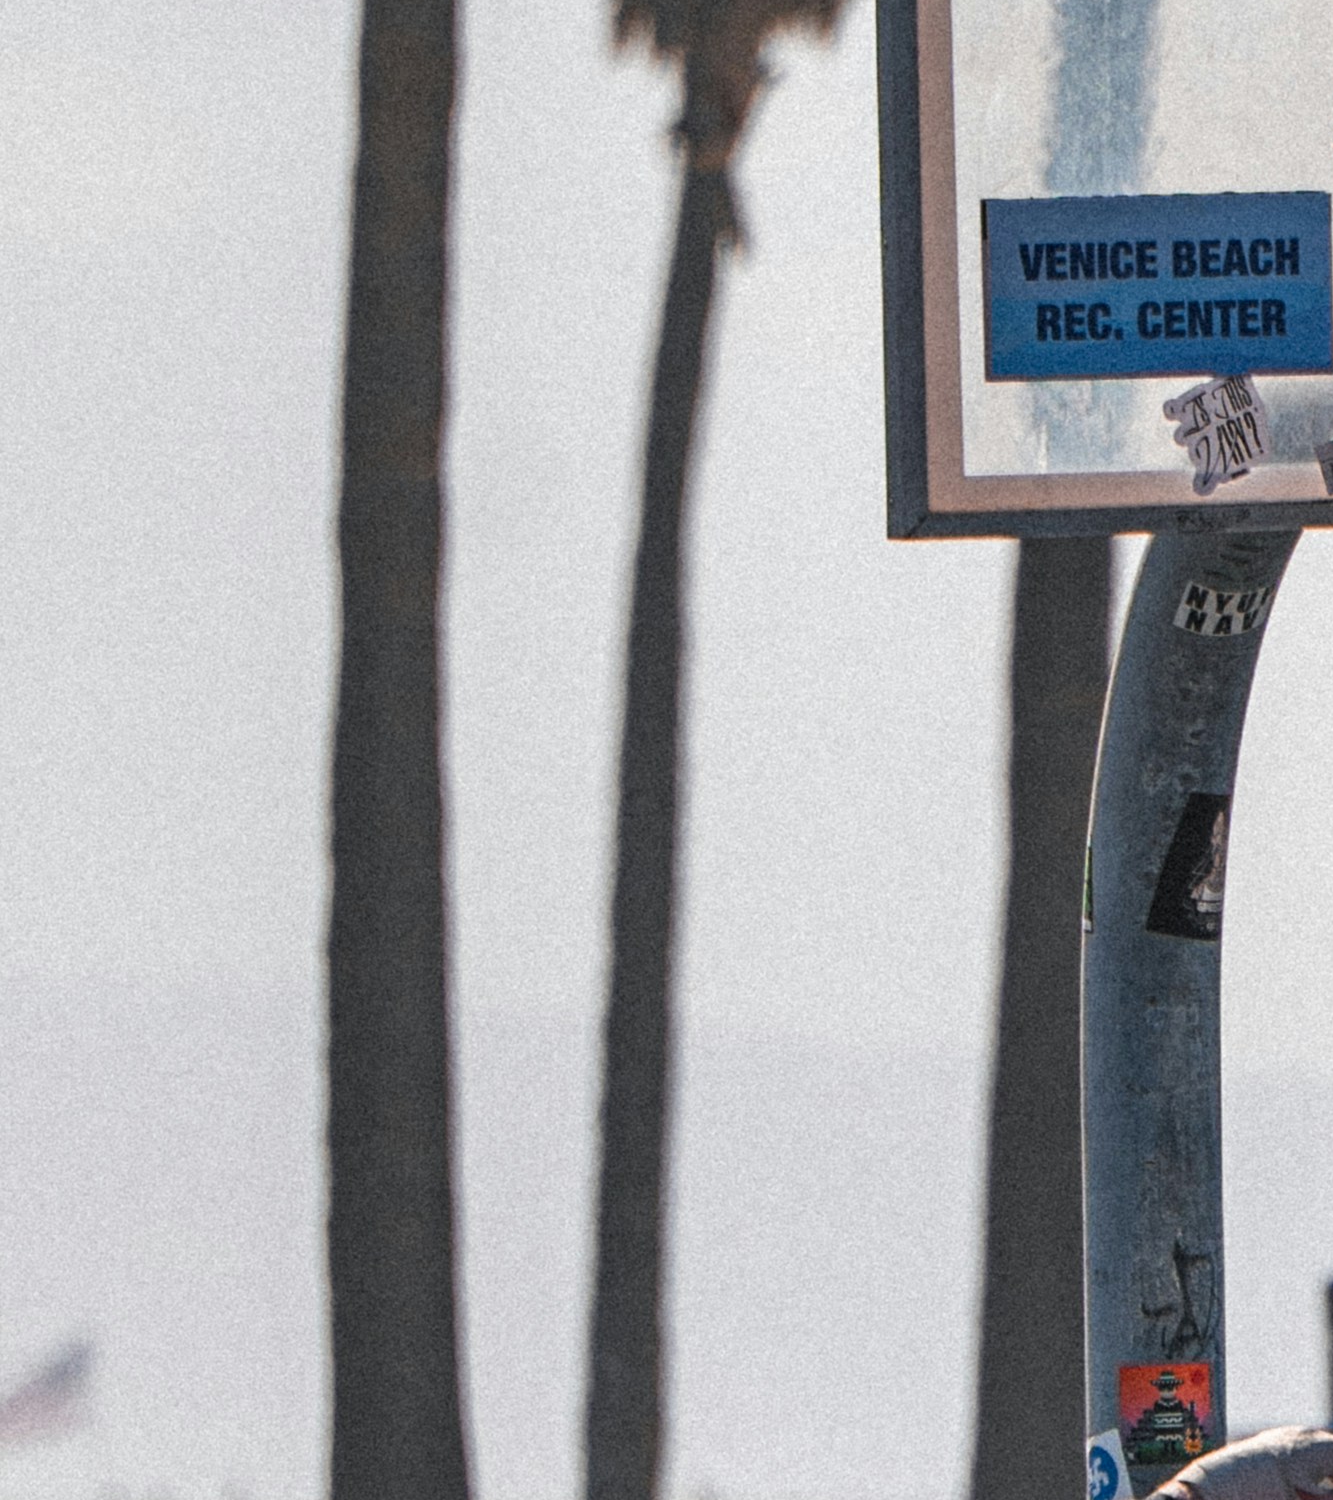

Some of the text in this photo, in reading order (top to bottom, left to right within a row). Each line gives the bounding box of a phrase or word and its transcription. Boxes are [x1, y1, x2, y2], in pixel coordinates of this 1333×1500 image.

[1020, 238, 1300, 281] VENICE BEACH
[1036, 299, 1287, 342] REC. CENTER
